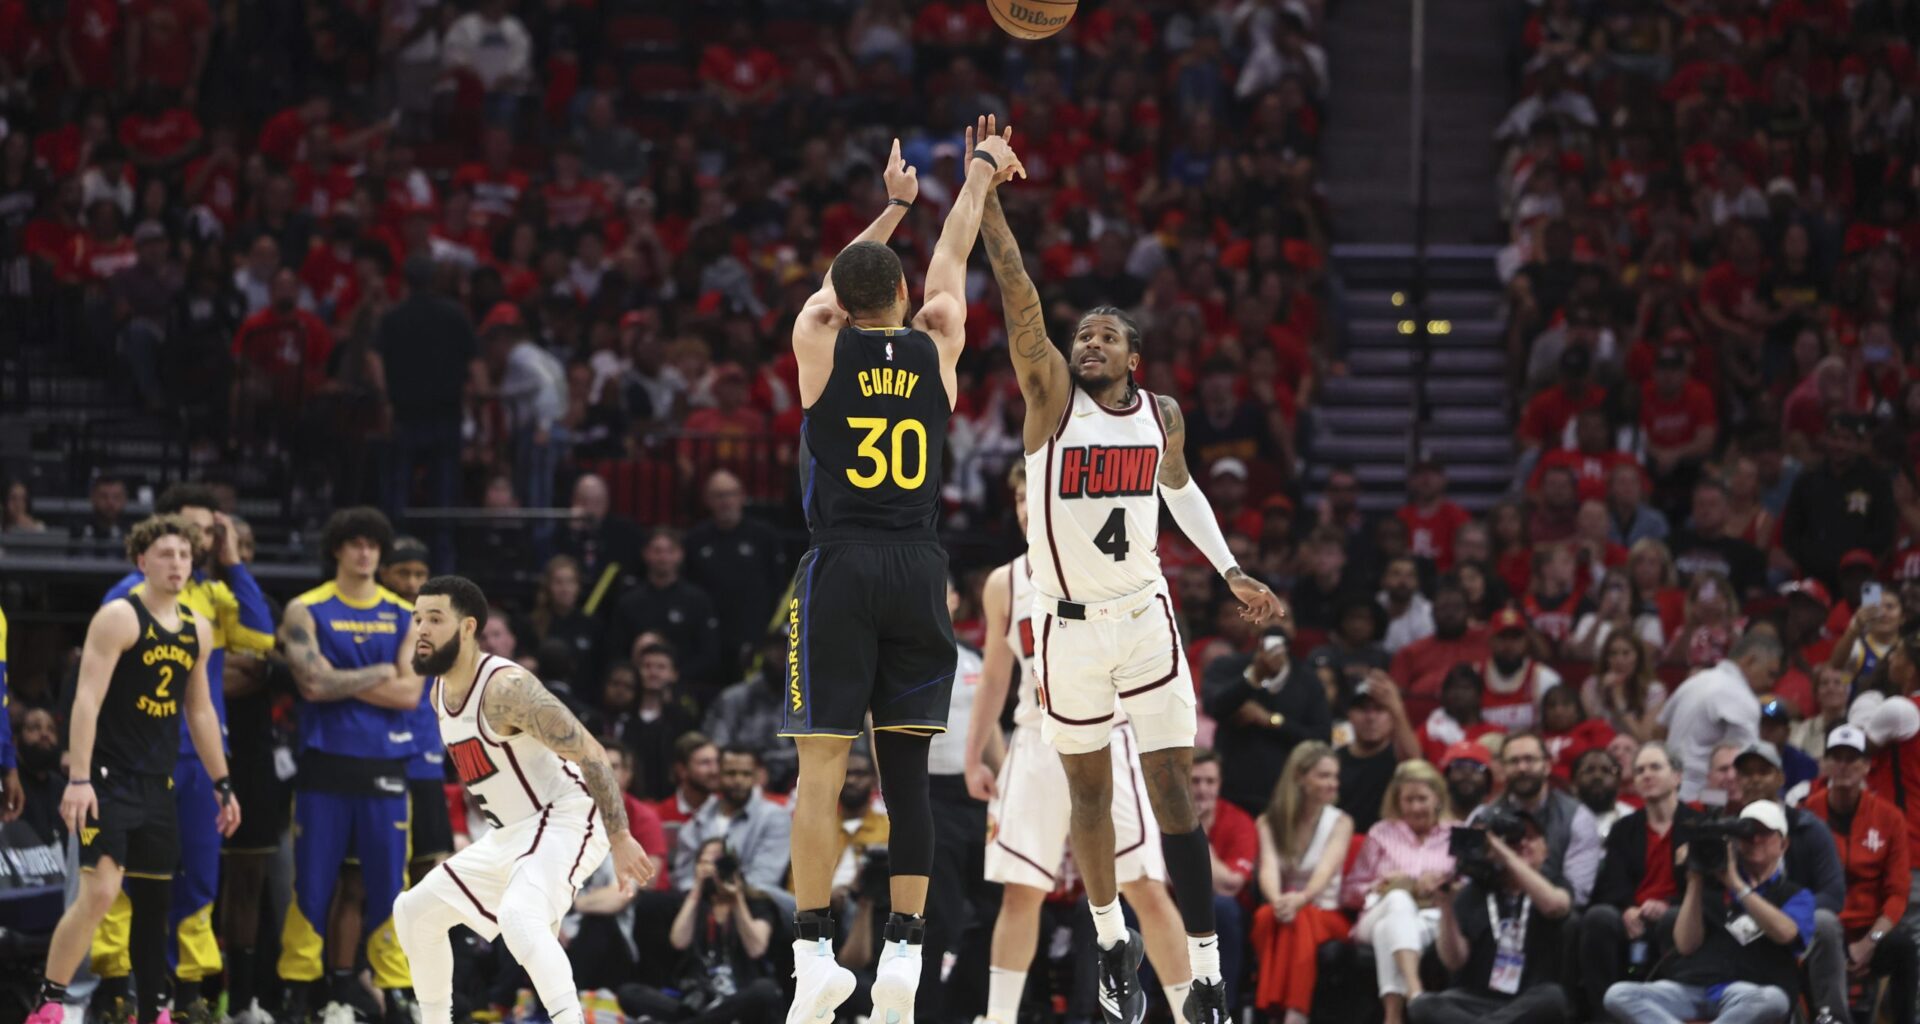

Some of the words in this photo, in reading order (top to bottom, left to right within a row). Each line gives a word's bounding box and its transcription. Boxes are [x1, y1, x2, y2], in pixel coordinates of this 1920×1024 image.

[1010, 3, 1067, 26] Wilson
[857, 367, 920, 399] CURRY
[846, 416, 928, 491] 30
[1093, 507, 1129, 562] 4
[142, 644, 195, 671] GOLDEN
[789, 597, 803, 712] WARRIORS
[155, 665, 174, 698] 2
[136, 694, 178, 717] STATE
